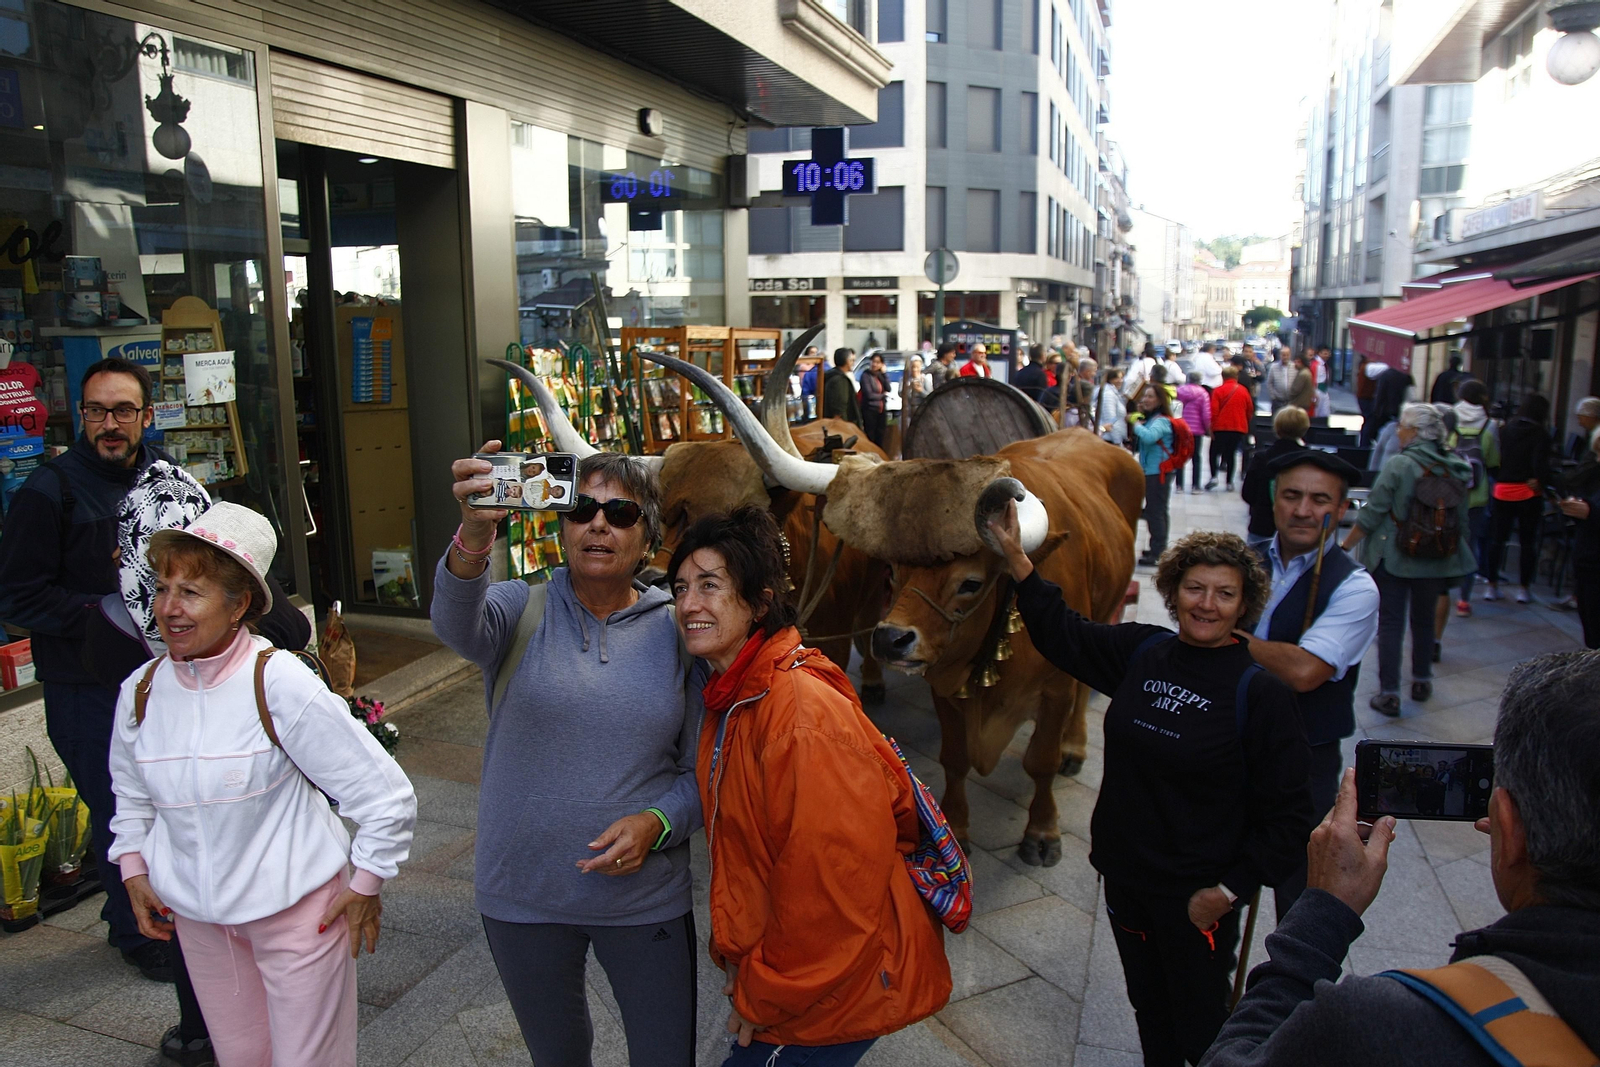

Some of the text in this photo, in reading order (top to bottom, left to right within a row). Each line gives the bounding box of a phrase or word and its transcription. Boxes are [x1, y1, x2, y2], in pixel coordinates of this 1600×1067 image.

[792, 162, 865, 192] 10:06
[788, 278, 814, 290] Sol
[195, 359, 216, 368] MERCA
[15, 406, 36, 414] URGO
[13, 444, 33, 453] URGO
[1151, 697, 1184, 714] ART.
[1160, 728, 1180, 739] STUDIO
[14, 843, 41, 859] Aloe
[652, 934, 672, 942] adidas
